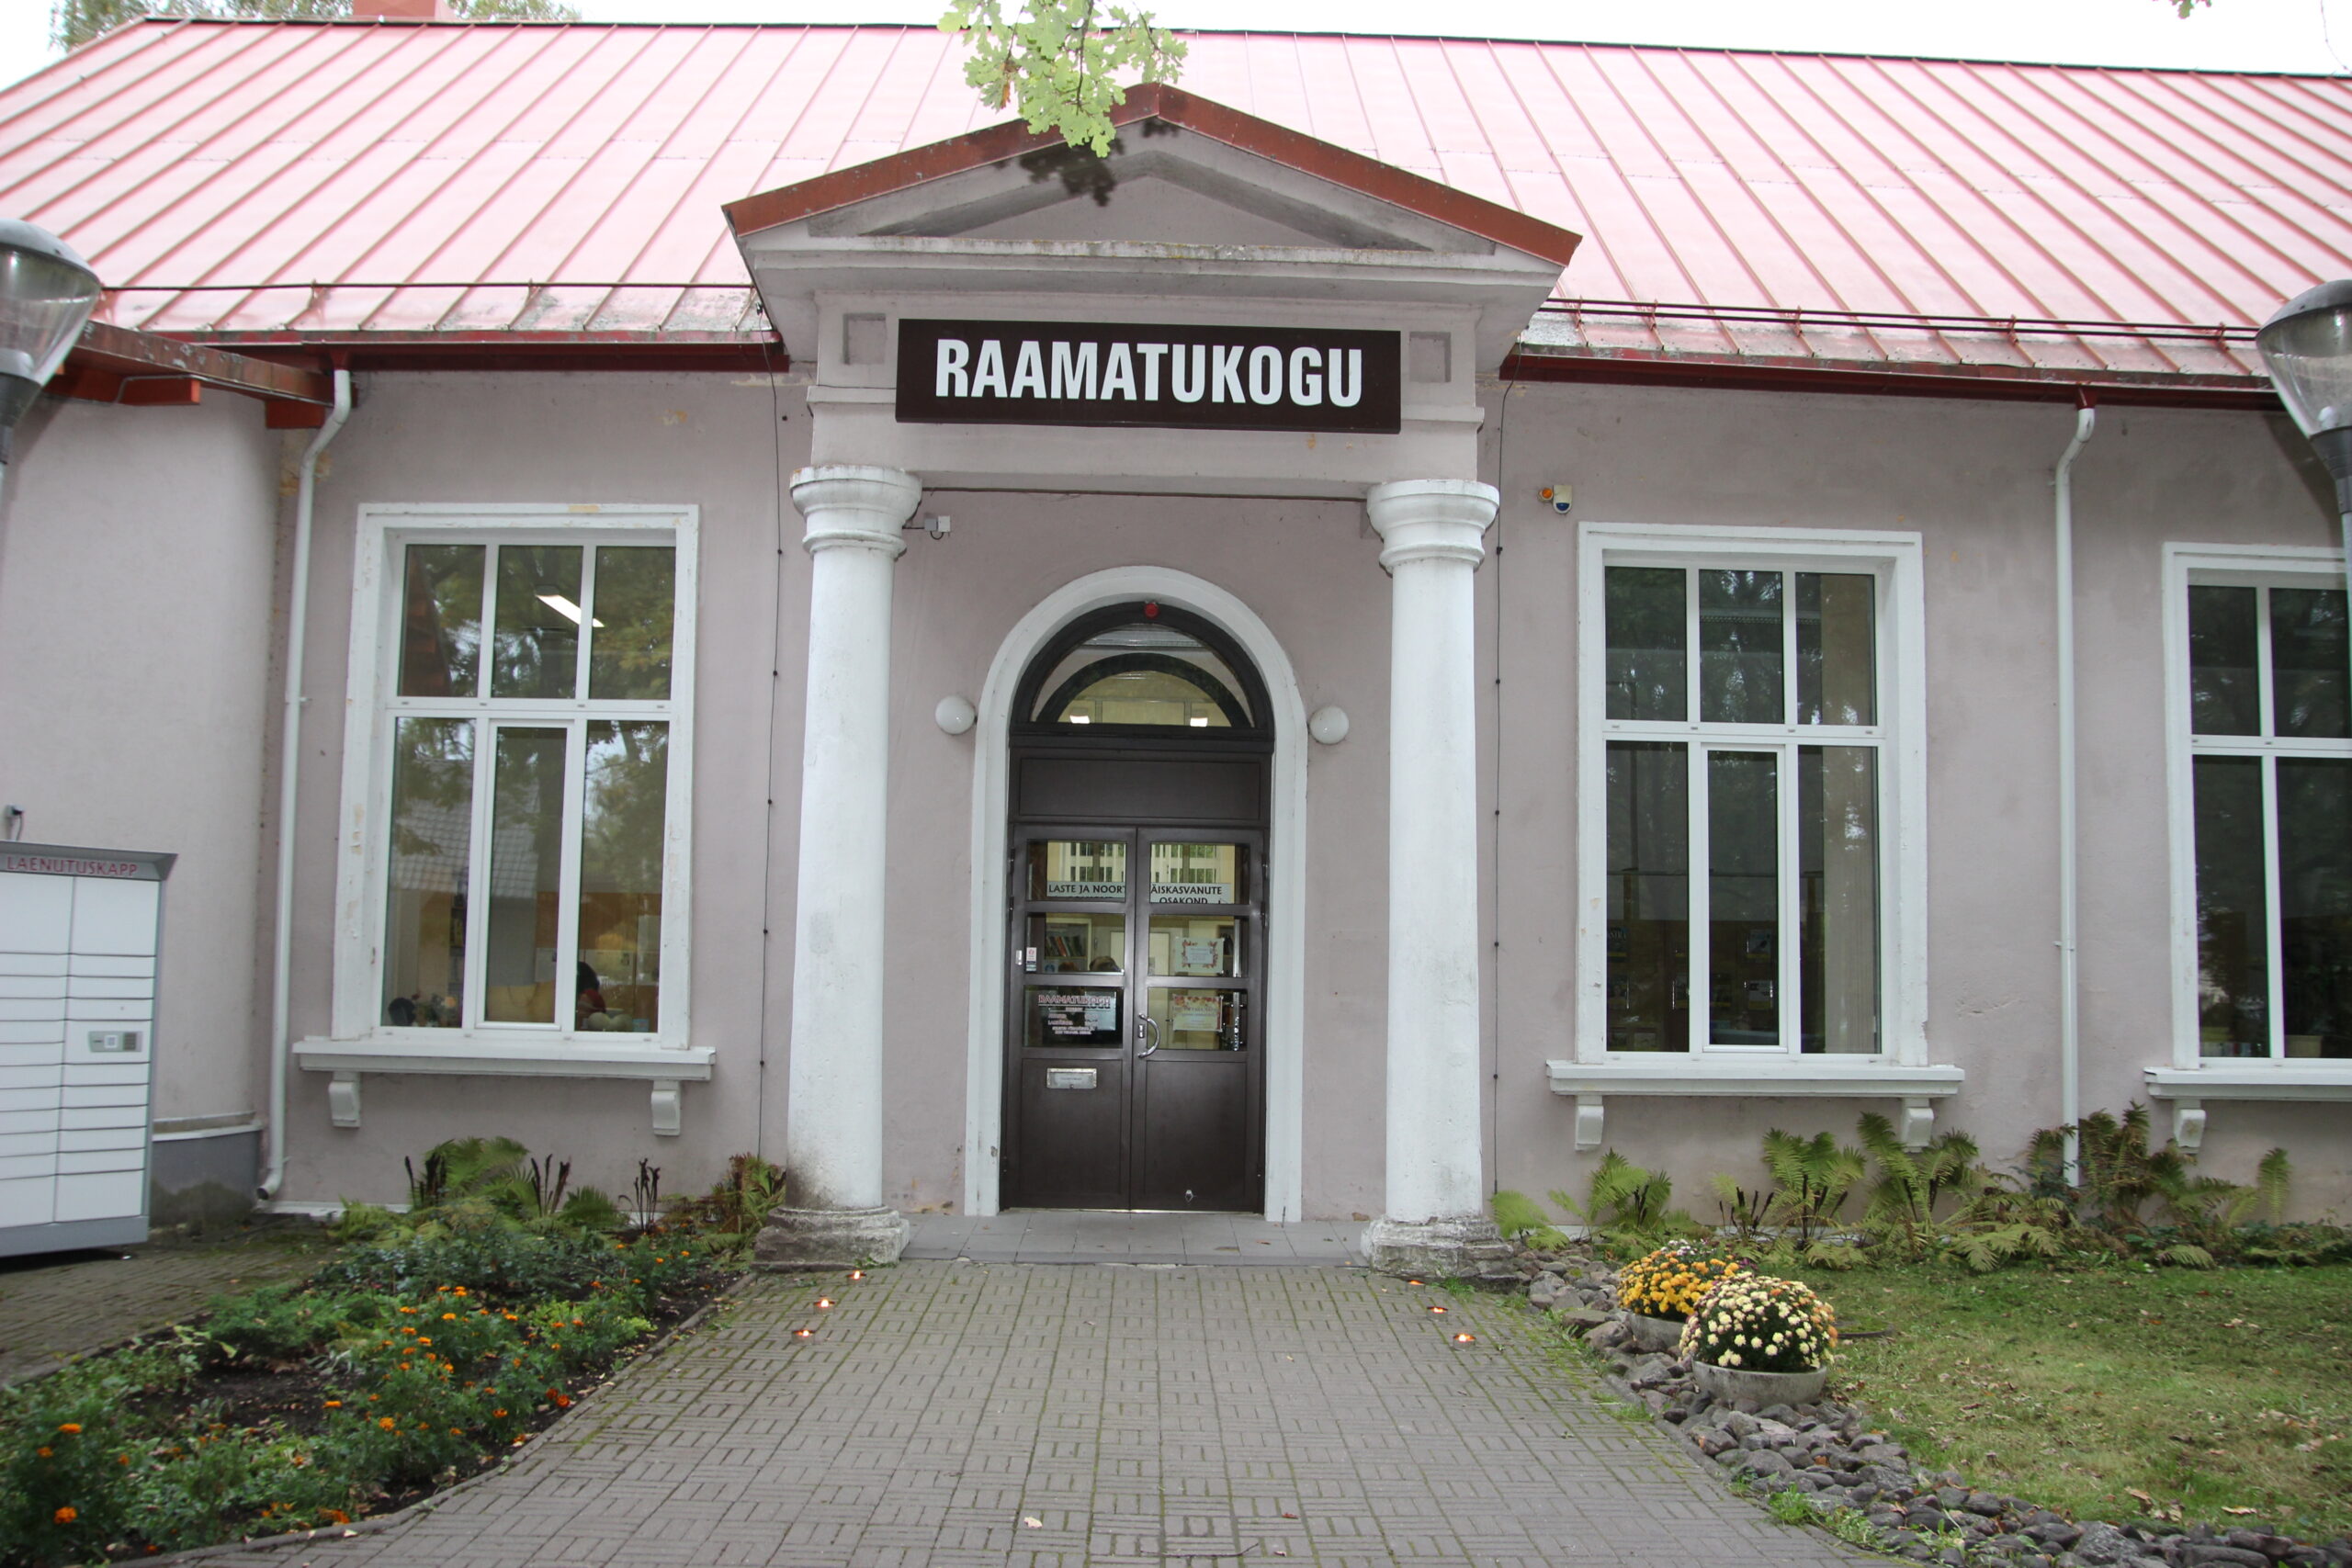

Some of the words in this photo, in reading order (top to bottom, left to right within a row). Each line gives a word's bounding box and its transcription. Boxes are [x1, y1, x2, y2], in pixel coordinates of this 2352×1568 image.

[935, 338, 1363, 408] RAAMATUKOGU
[6, 856, 137, 876] LAENUTUSKAPP
[1048, 885, 1076, 893] LASTE
[1079, 885, 1090, 894] JA
[1038, 995, 1111, 1005] RAAMATUKOGU
